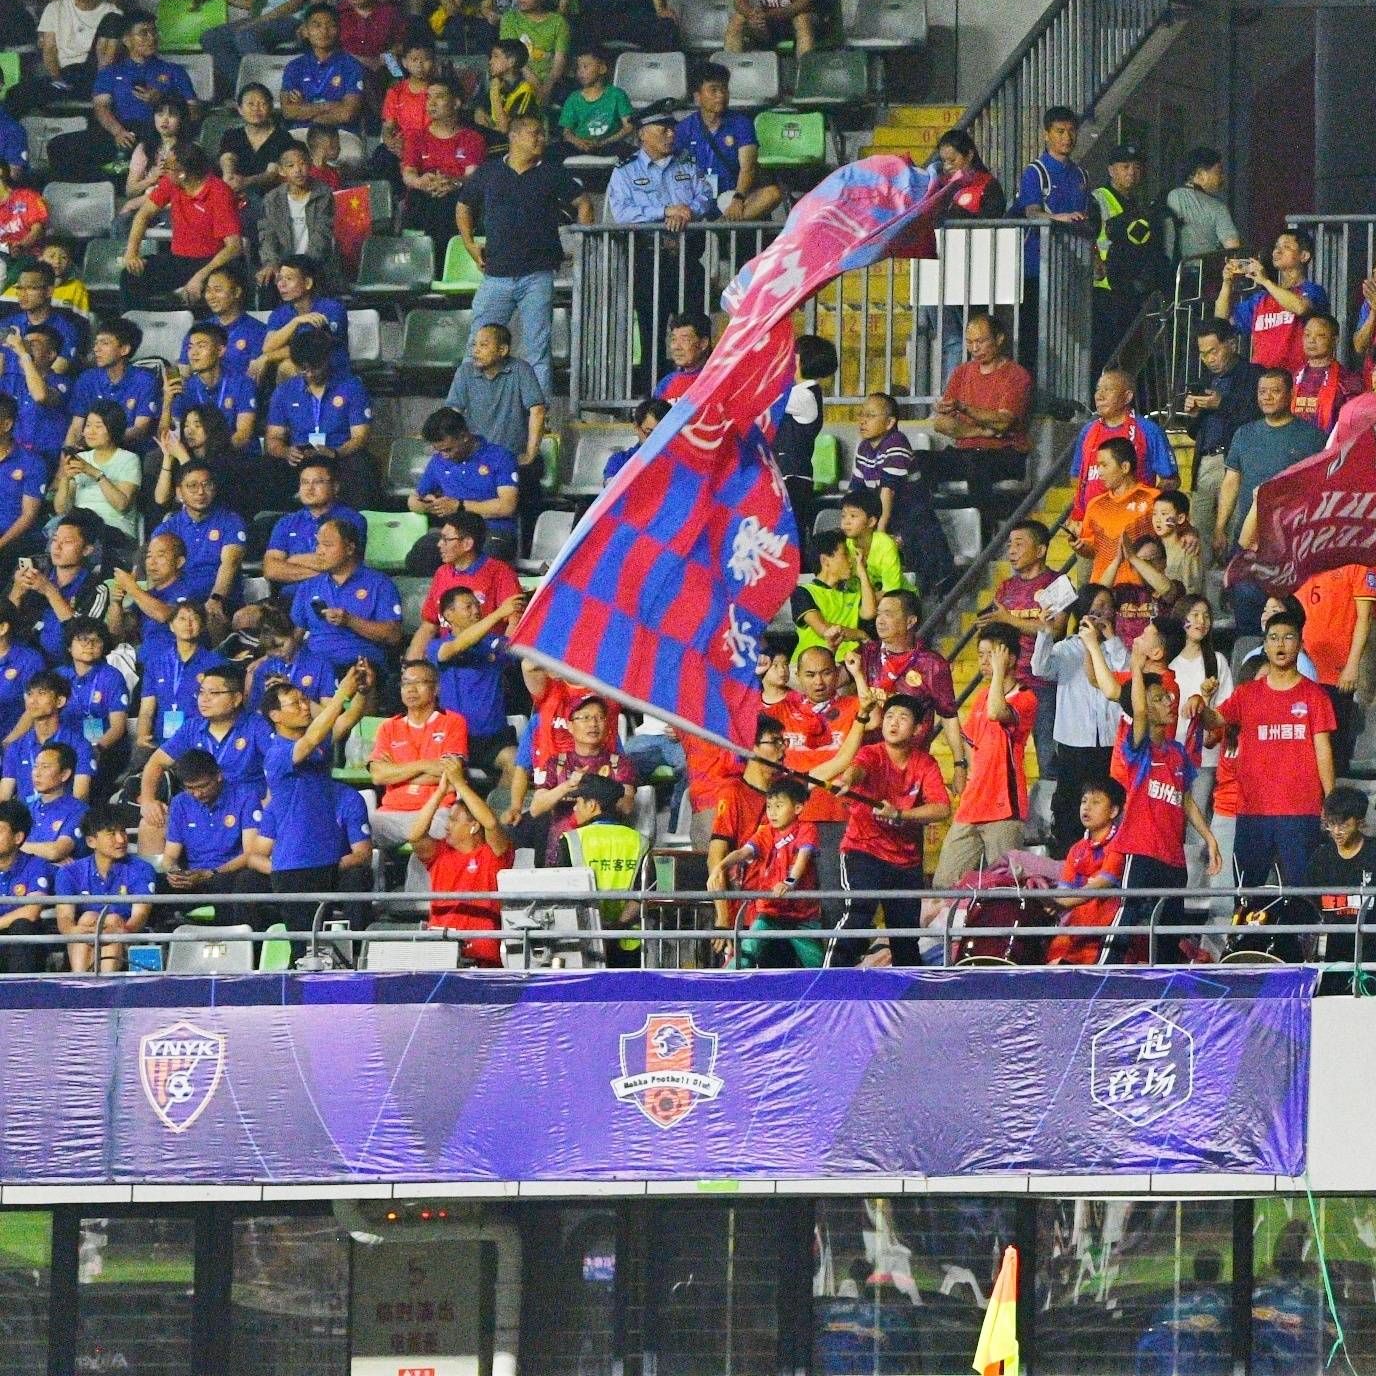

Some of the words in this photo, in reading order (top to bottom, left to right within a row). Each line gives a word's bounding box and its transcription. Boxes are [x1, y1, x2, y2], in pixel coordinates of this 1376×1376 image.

[589, 858, 638, 873] 广东客安
[148, 1039, 217, 1057] YNYK
[1107, 1063, 1178, 1103] 登场
